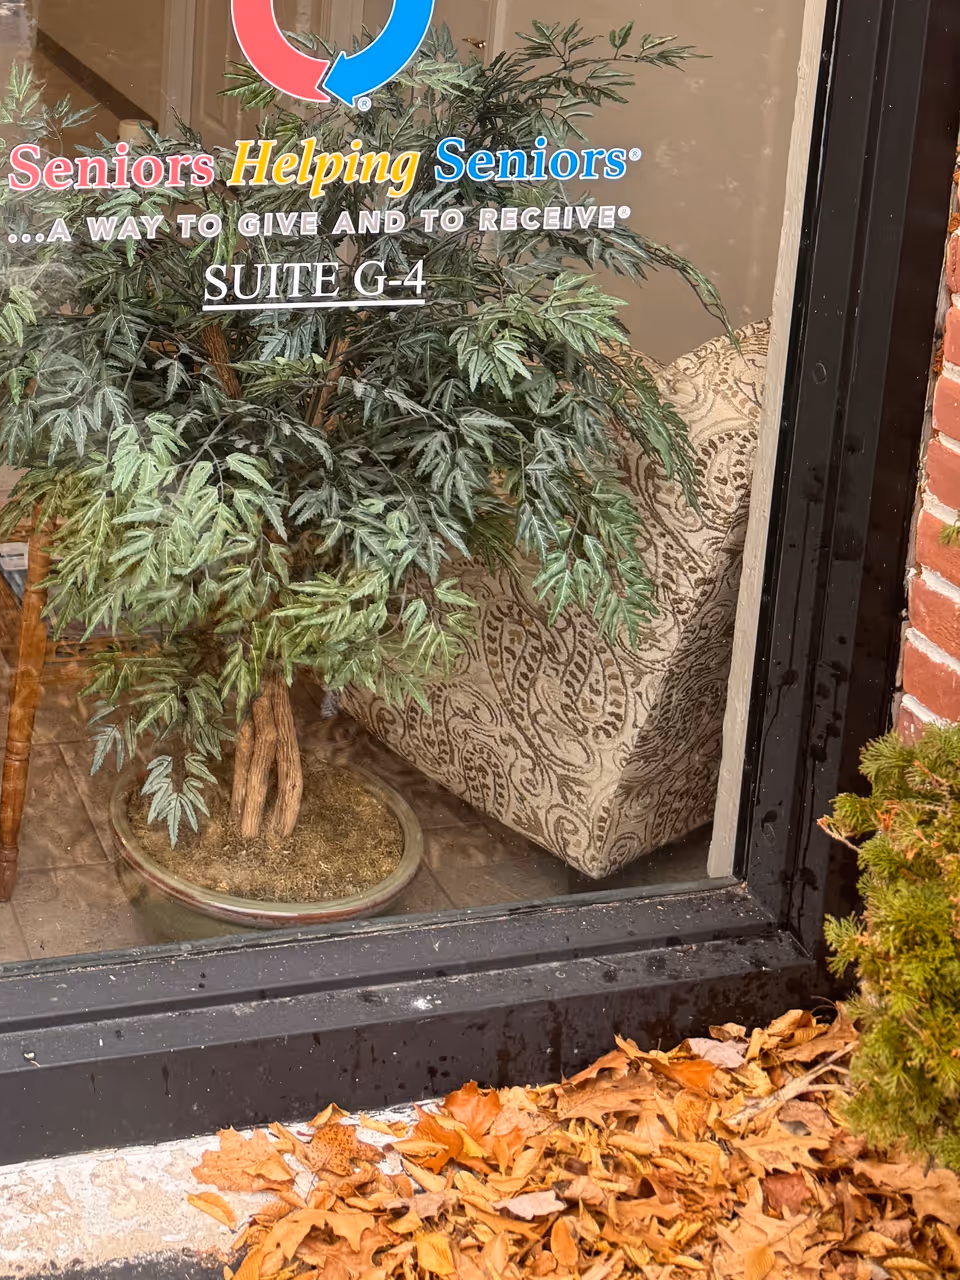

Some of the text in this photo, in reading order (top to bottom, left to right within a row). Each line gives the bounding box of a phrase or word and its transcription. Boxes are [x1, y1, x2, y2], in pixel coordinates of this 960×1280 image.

[7, 141, 215, 191] Seniors
[227, 137, 421, 200] Helping
[86, 215, 164, 241] WAY
[176, 213, 222, 238] TO
[237, 211, 320, 236] GIVE
[331, 210, 406, 235] AND
[420, 207, 464, 232] TO
[203, 259, 427, 302] SUITE G-4
